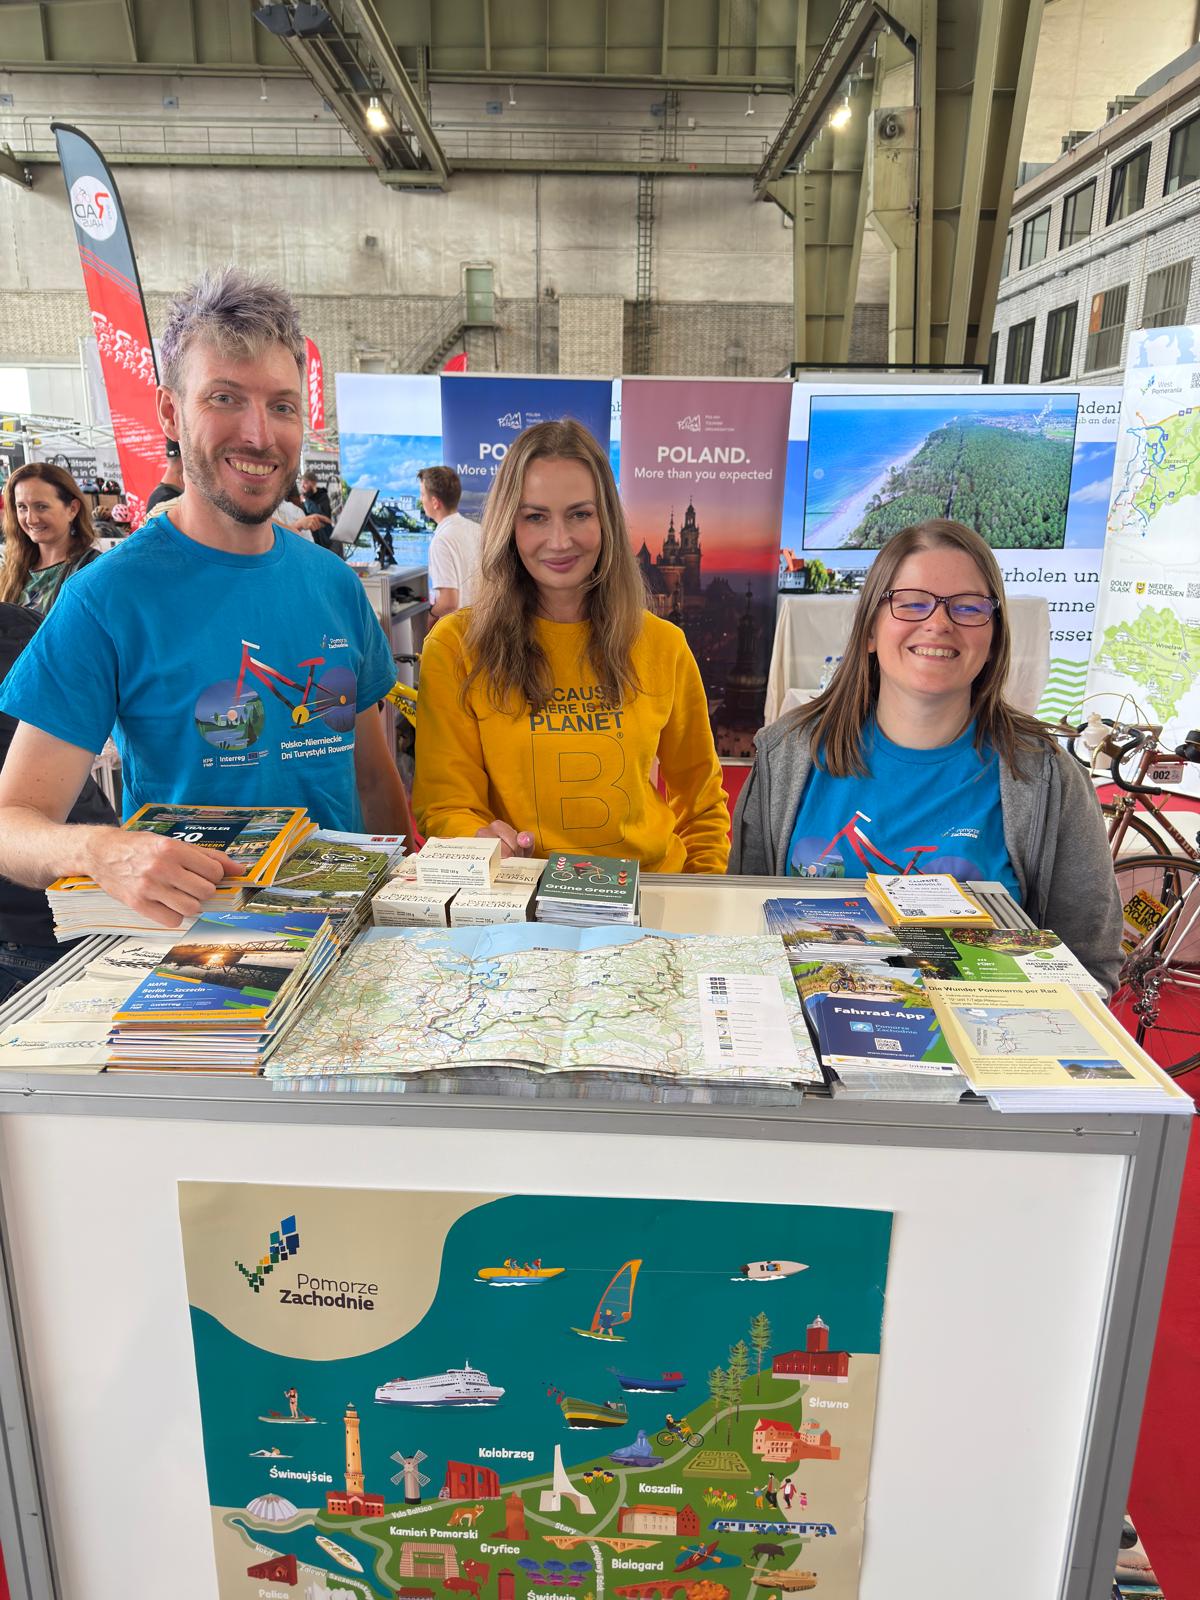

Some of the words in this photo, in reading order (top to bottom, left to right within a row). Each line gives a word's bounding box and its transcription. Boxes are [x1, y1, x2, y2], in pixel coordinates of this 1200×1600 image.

[1101, 417, 1115, 425] der
[657, 446, 751, 464] POLAND.
[457, 463, 487, 476] More
[634, 467, 664, 479] More
[667, 468, 693, 479] than
[695, 471, 717, 483] you
[719, 469, 773, 484] expected
[1001, 567, 1067, 583] rholen
[1074, 572, 1099, 583] un
[1109, 579, 1133, 588] DOLNY
[1147, 588, 1185, 598] SCHLESIEN
[583, 703, 599, 713] IS
[530, 711, 624, 733] PLANET
[280, 735, 343, 750] Polsko-Niemieckie
[219, 755, 246, 763] Interreg
[281, 752, 293, 760] Dni
[294, 746, 327, 759] Turystyki
[1152, 770, 1170, 780] 002
[531, 733, 631, 850] B
[172, 831, 204, 843] 20
[545, 883, 583, 892] Grüne
[584, 886, 628, 895] Grenze
[1129, 894, 1162, 924] RETRO
[1123, 904, 1155, 932] CYCLING
[834, 1007, 926, 1021] Fahrrad-App
[297, 1273, 379, 1296] Pomorze
[279, 1289, 375, 1311] Zachodnie
[269, 1464, 333, 1484] Świnoujście
[638, 1482, 684, 1496] Koszalin
[389, 1525, 428, 1538] Kamień
[429, 1527, 479, 1540] Pomorski
[554, 1521, 577, 1535] Stary
[479, 1542, 521, 1555] Gryfice
